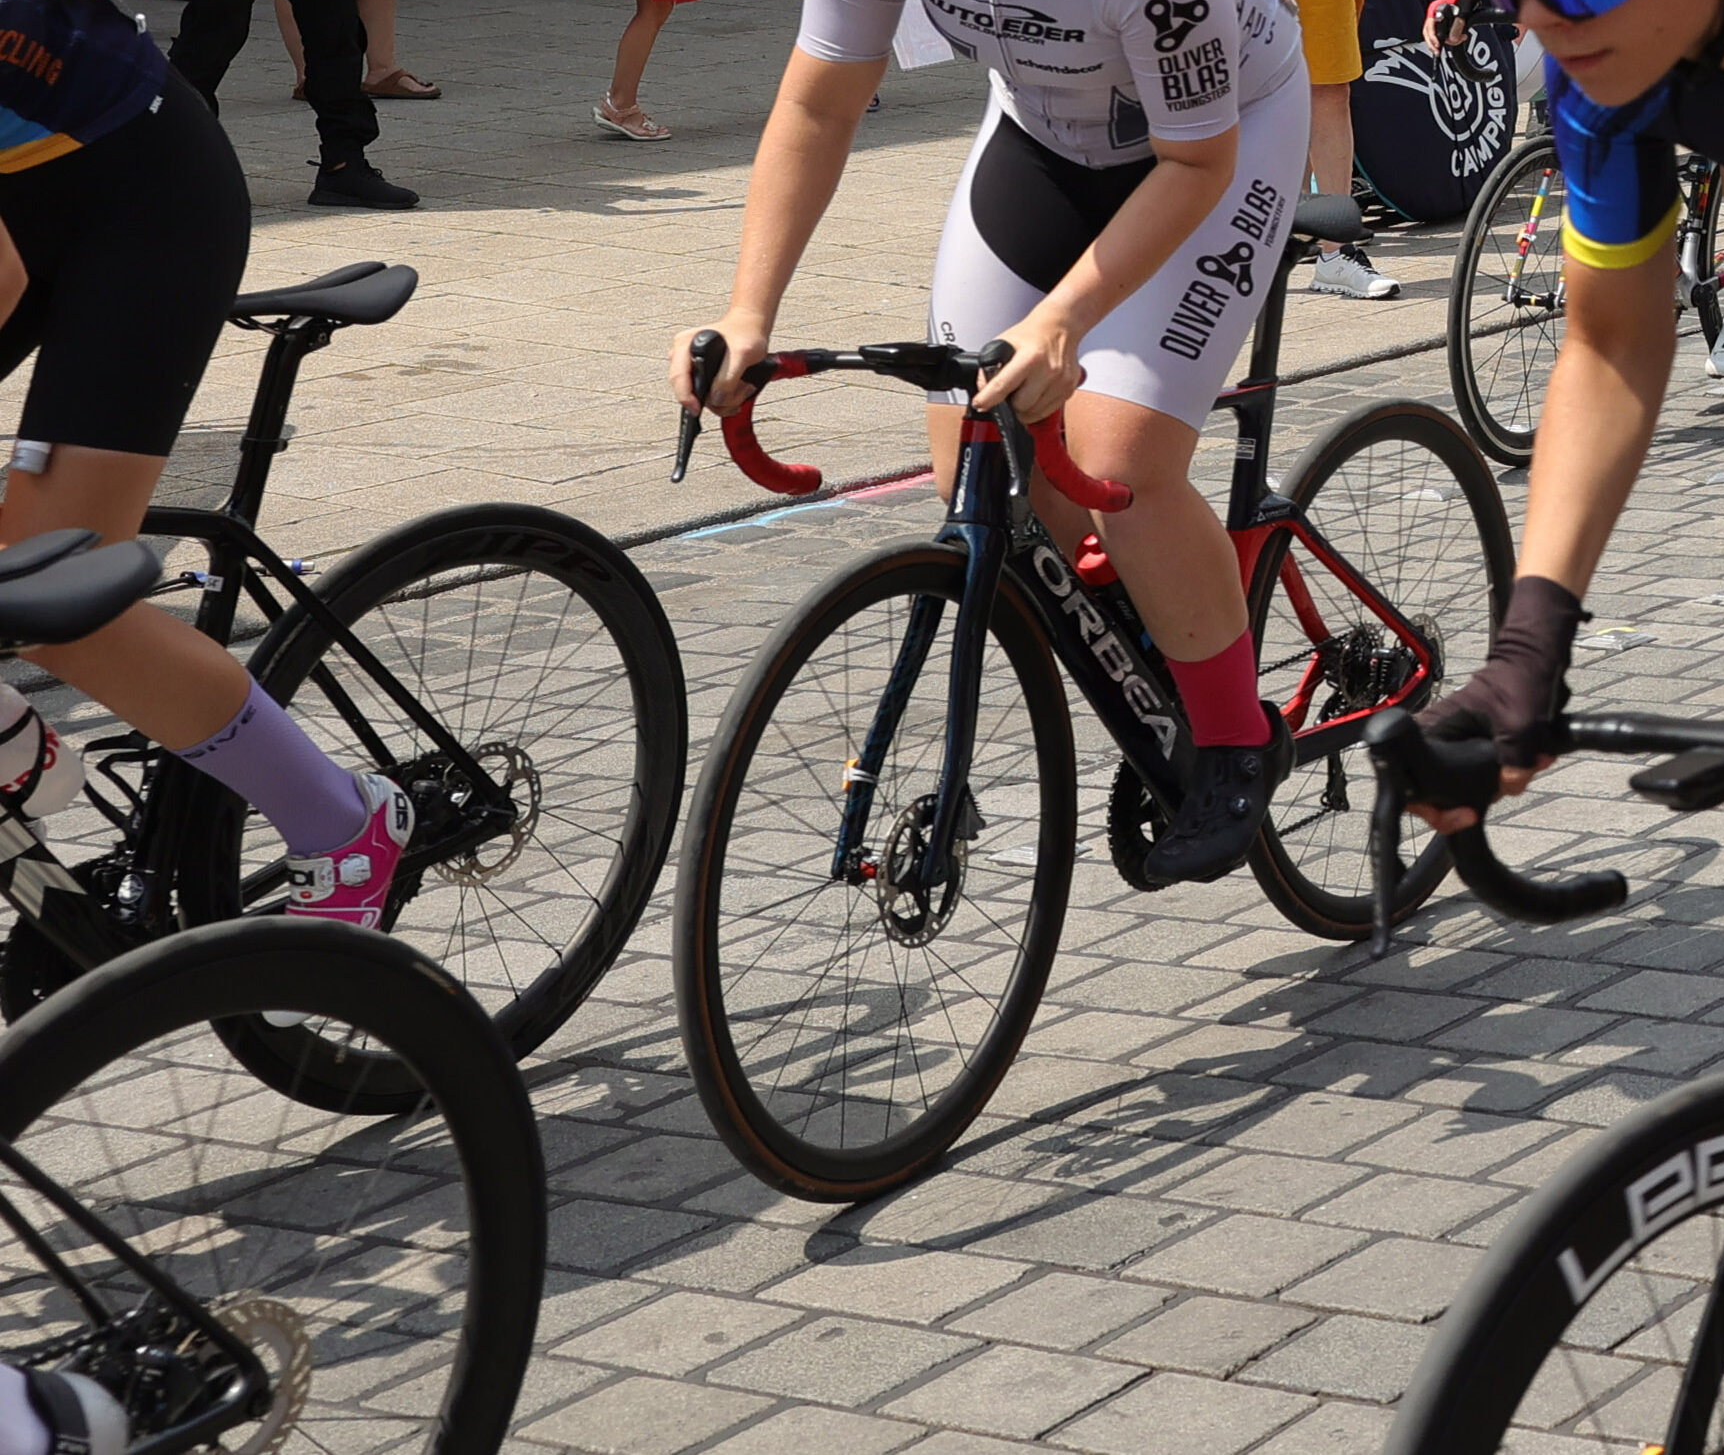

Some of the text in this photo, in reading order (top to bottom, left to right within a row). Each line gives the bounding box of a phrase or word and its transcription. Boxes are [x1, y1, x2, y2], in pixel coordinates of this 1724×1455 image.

[1001, 17, 1086, 44] EDER
[1015, 56, 1105, 76] schattdecor
[1158, 36, 1226, 76] OLIVER
[1161, 56, 1231, 103] BLAS
[1164, 83, 1232, 114] YOUNGSTERS
[1230, 178, 1279, 242] BLAS
[1263, 195, 1287, 249] YOUNGSTERS
[1159, 279, 1231, 361] OLIVER
[954, 447, 973, 514] ORBEA
[1032, 545, 1178, 761] ORBEA
